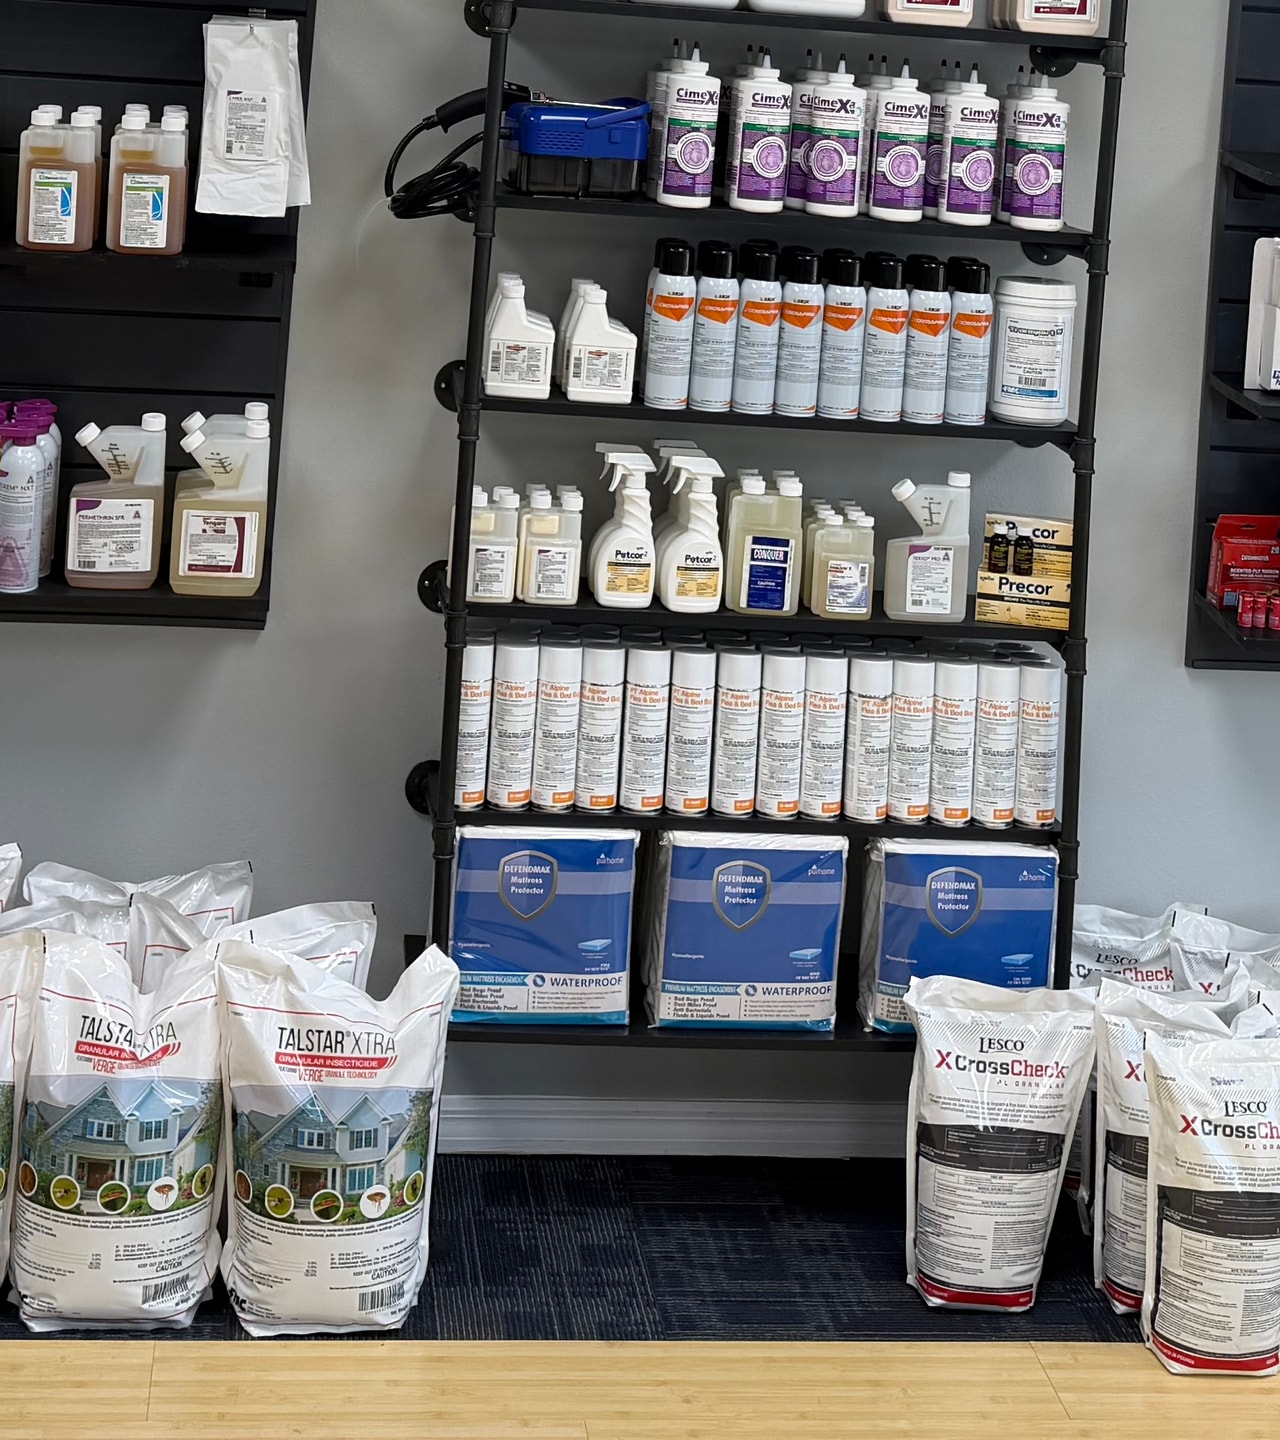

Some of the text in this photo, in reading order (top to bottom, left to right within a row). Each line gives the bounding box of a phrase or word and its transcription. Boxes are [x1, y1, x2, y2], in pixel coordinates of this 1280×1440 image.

[1005, 521, 1059, 540] Pcor
[615, 549, 644, 560] Petcor
[685, 555, 713, 565] Petcor
[753, 548, 784, 561] CONQUER
[999, 576, 1054, 596] Precor
[504, 865, 550, 874] DEFENDMAX
[511, 875, 543, 885] Mattress
[718, 875, 764, 884] DEFENDMAX
[931, 881, 976, 891] DEFENDMAX
[510, 886, 544, 895] Protector
[724, 885, 756, 894] Mattress
[724, 896, 757, 905] Protector
[937, 892, 968, 901] Mattress
[937, 902, 970, 911] Protector
[1096, 953, 1138, 966] LESCO
[550, 975, 623, 988] WATERPROOF
[762, 984, 832, 996] WATERPROOF
[351, 1031, 396, 1055] XTRA
[979, 1037, 1025, 1053] LESCO
[92, 1058, 116, 1074] VERGE
[279, 1055, 378, 1068] GRANULAR INSECTICIDE
[955, 1054, 1067, 1079] CrossCheck
[299, 1069, 324, 1083] VERGE
[1224, 1101, 1267, 1117] LESCO
[371, 1266, 401, 1280] CAUTION
